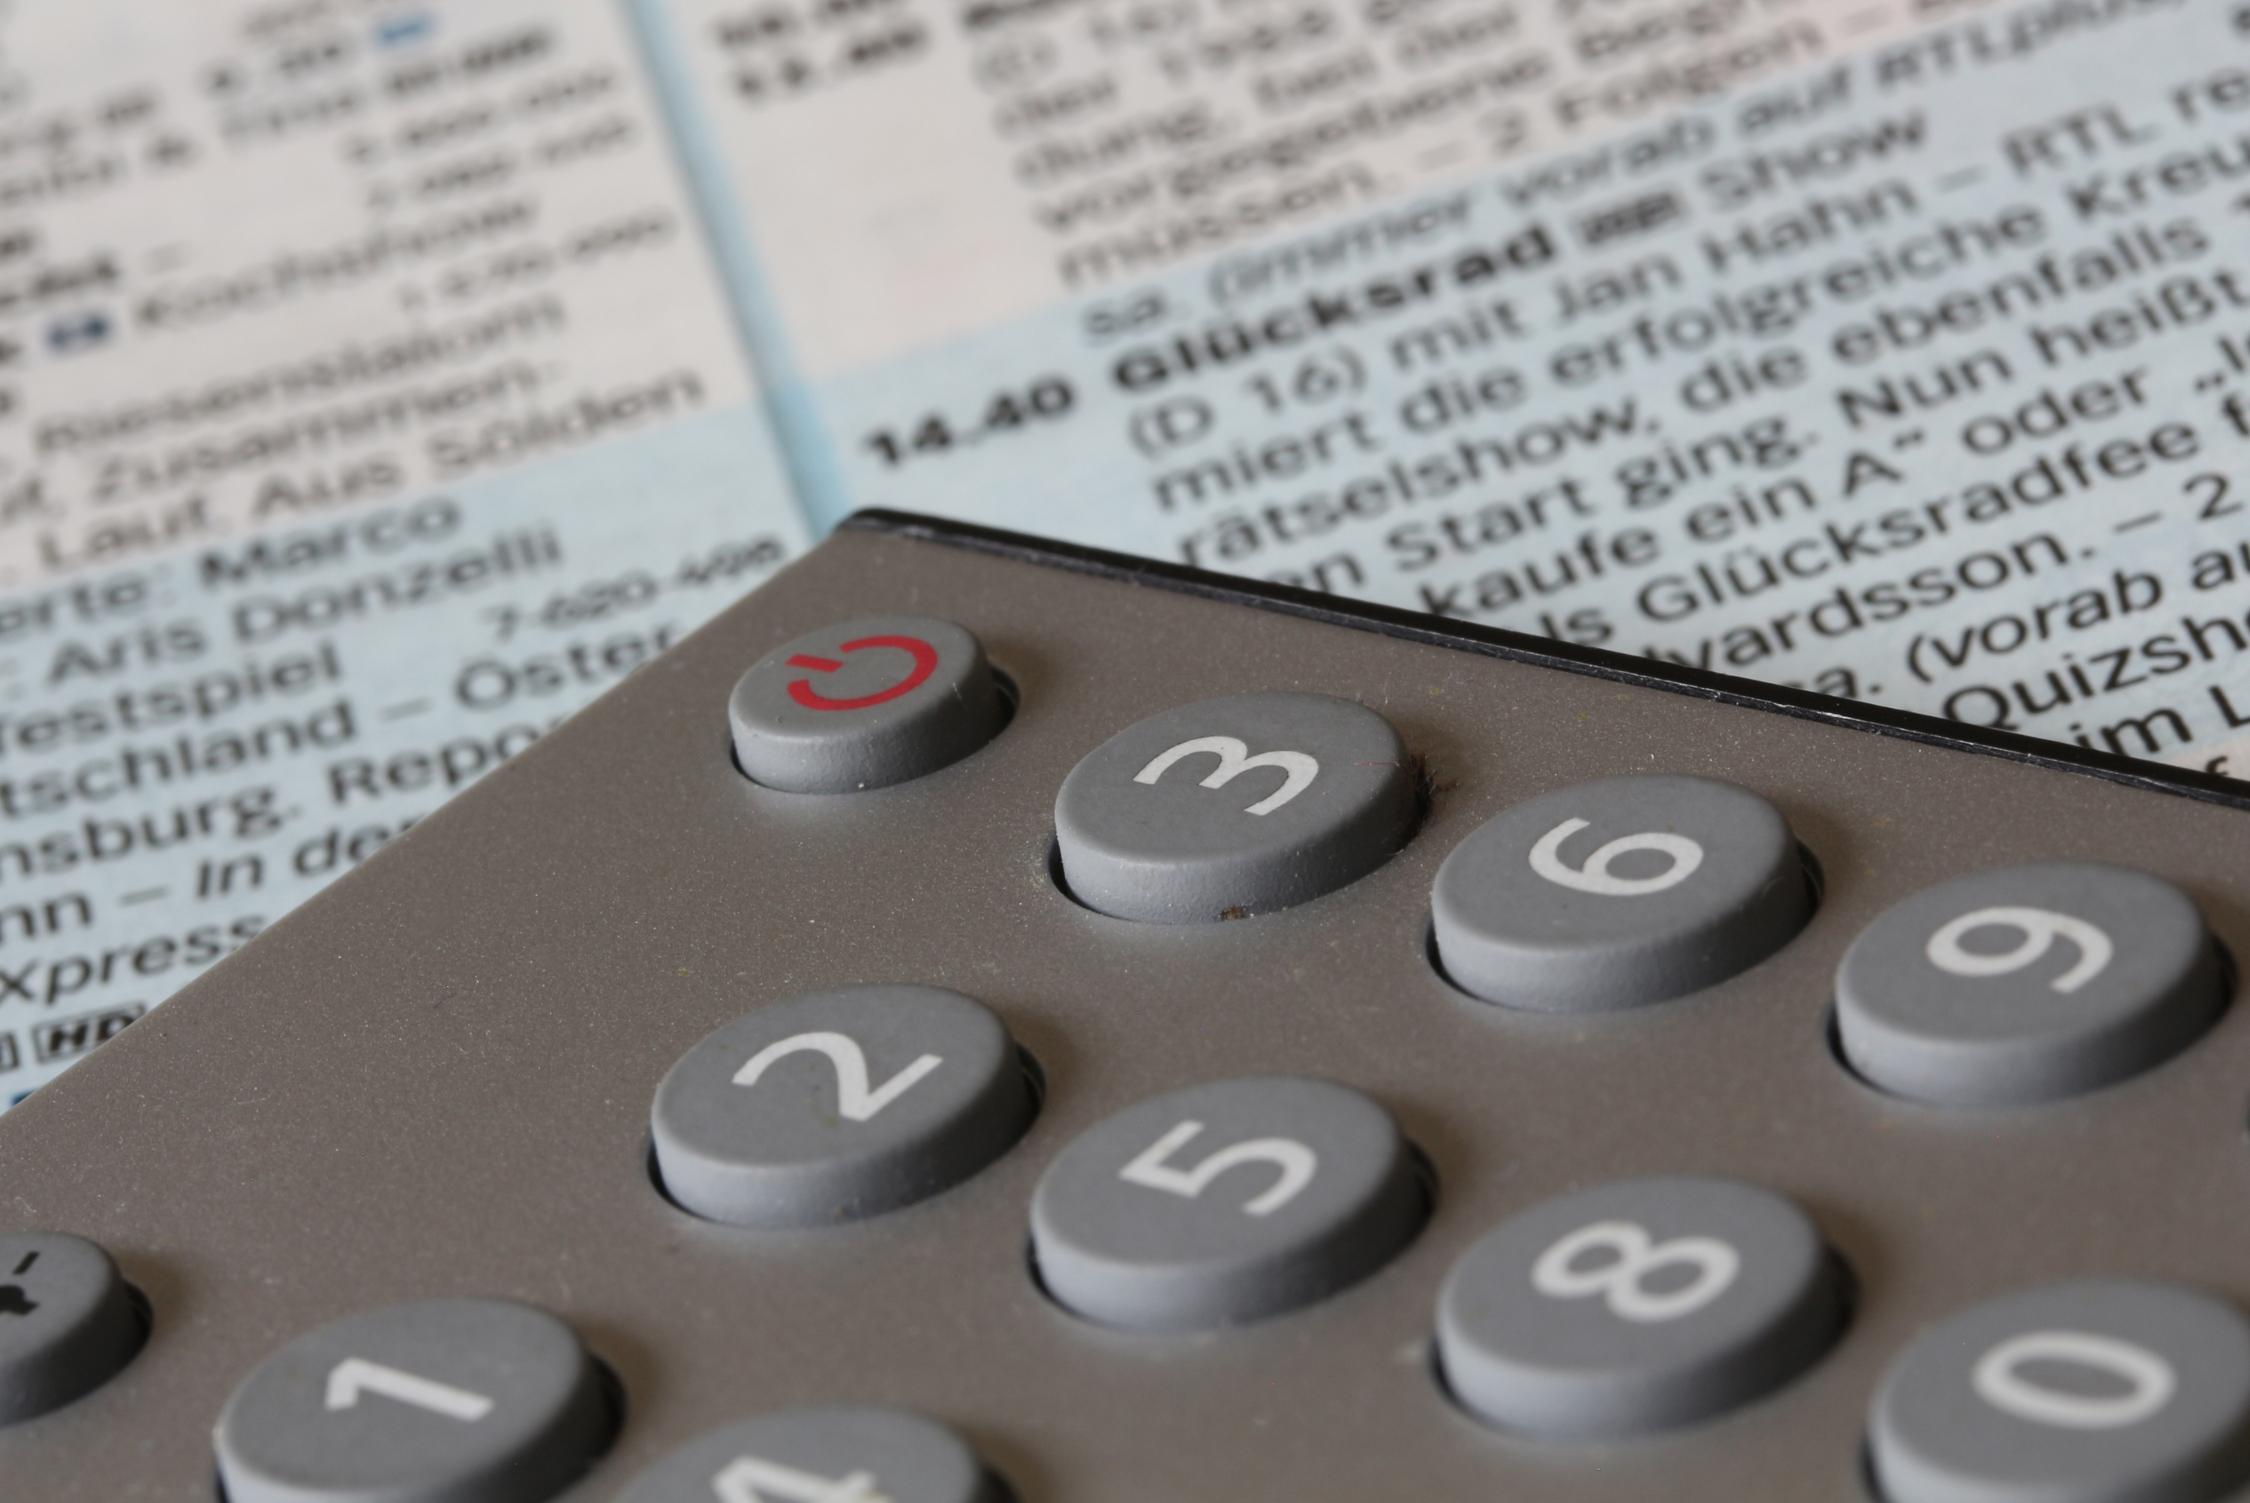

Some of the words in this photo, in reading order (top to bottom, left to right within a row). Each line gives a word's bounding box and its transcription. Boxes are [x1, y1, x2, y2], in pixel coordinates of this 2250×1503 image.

[1500, 114, 1718, 207] vorab
[1737, 62, 1852, 137] auf
[863, 375, 1079, 470] 14.40
[1108, 223, 1557, 392] Glücksrad
[1698, 107, 1928, 211] Show
[1389, 298, 1530, 367] mit
[1555, 253, 1682, 322] Jan
[1700, 176, 1920, 273] Hahn
[2002, 104, 2162, 177] RTL
[1152, 406, 1381, 512] miert
[1399, 368, 1527, 434] die
[1549, 203, 2046, 387] erfolgreiche
[1679, 345, 1806, 416] die
[1830, 218, 2211, 365] ebenfalls
[1385, 475, 1593, 570] Start
[1614, 415, 1821, 509] ging.
[1836, 348, 2014, 429] Nun
[2029, 268, 2250, 368] heißt
[199, 492, 462, 587] Marco
[1417, 527, 1660, 618] kaufe
[1685, 473, 1818, 544] ein
[1962, 364, 2152, 455] oder
[1636, 423, 2200, 623] Glücksradfee
[2183, 472, 2245, 521] 2
[47, 618, 207, 690] Aris
[231, 517, 564, 645] Donzelli
[1906, 568, 2163, 684] (vorab
[2191, 540, 2250, 591] a
[0, 638, 342, 758] estspiel
[1943, 611, 2250, 732] Quizsh
[327, 713, 570, 806] Repo
[1132, 734, 1320, 817] 3
[194, 850, 266, 901] In
[1528, 816, 1705, 896] 6
[1925, 905, 2113, 993] 9
[732, 1031, 943, 1122] 2
[1119, 1120, 1317, 1216] 5
[1530, 1220, 1740, 1323] 8
[325, 1355, 494, 1422] 1
[1971, 1330, 2178, 1429] 0
